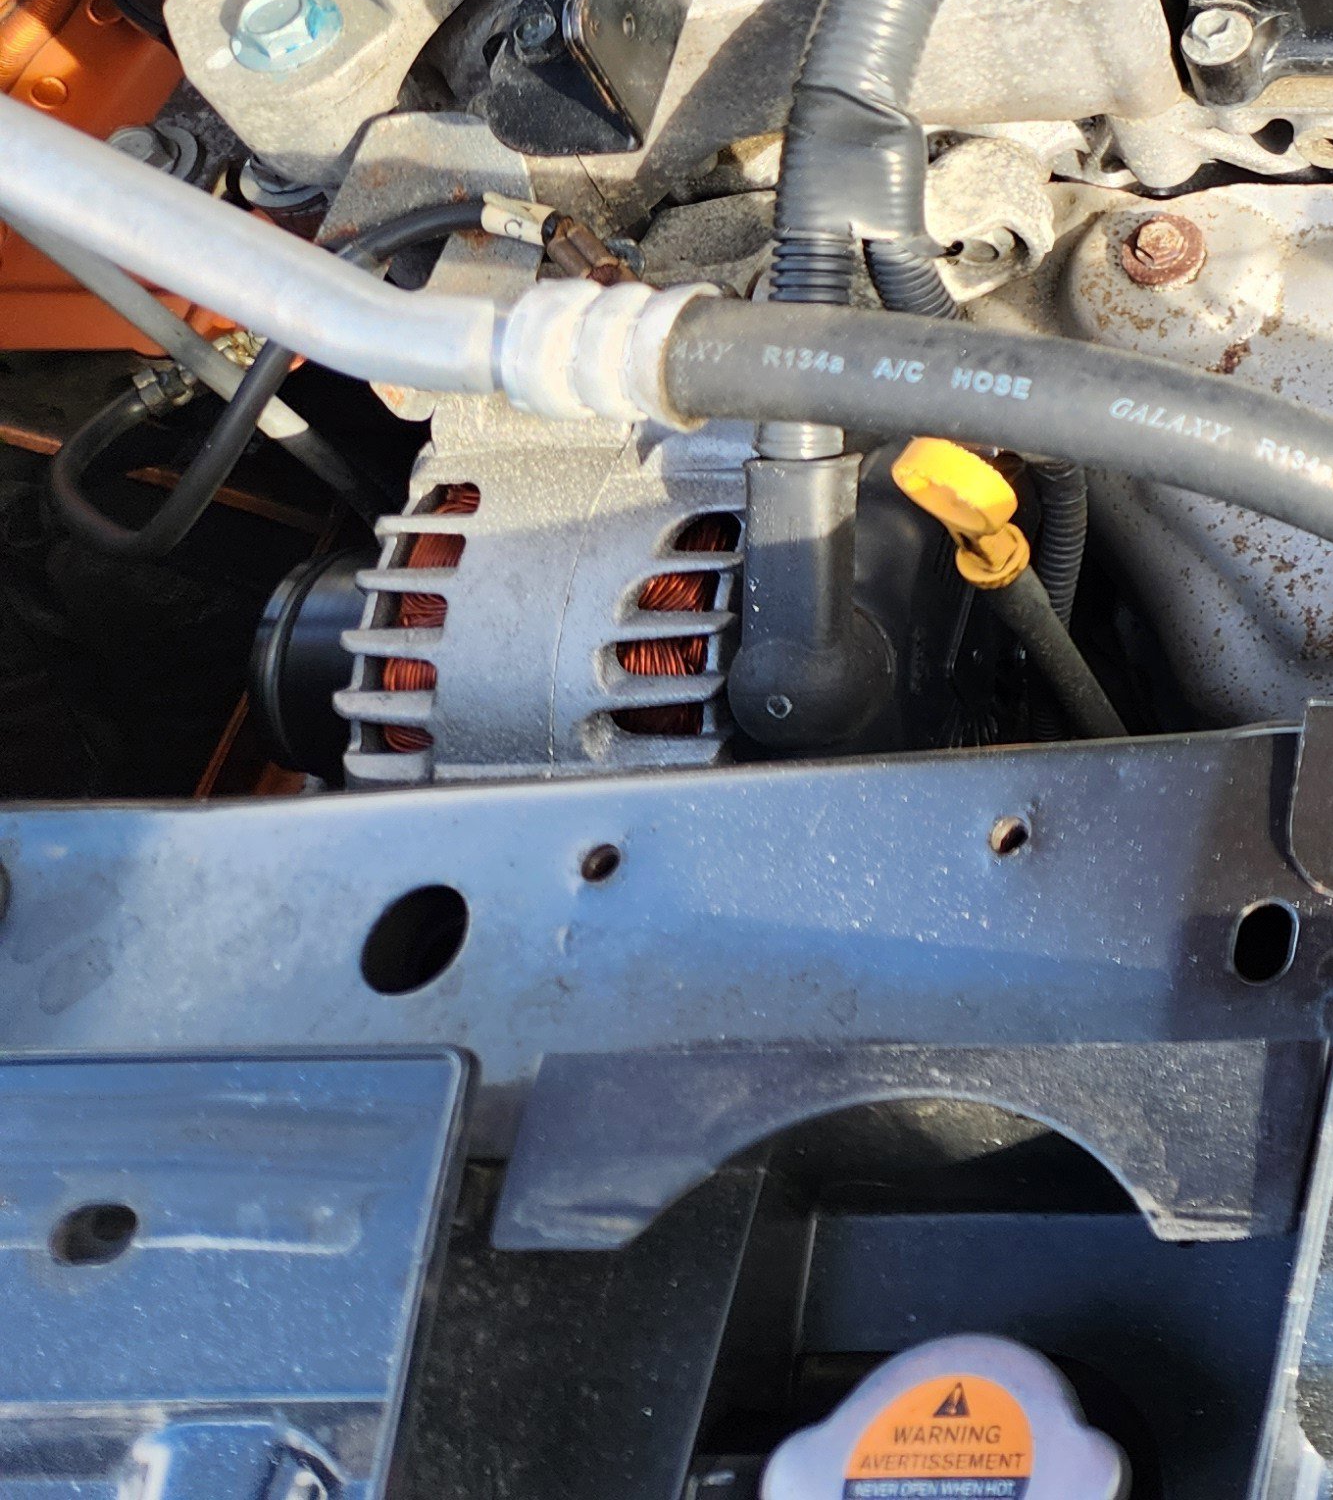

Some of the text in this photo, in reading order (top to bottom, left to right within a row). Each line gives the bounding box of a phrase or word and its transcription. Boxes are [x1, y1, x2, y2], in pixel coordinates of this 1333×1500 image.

[761, 344, 846, 375] R134a
[872, 356, 925, 383] A/C
[951, 366, 1033, 400] HOSE
[1109, 396, 1232, 443] GALAXY
[893, 1425, 1003, 1445] WARNING
[860, 1453, 1026, 1471] AVERTISSEMENT
[854, 1481, 899, 1497] NEVER
[901, 1480, 937, 1497] OPEN
[941, 1480, 984, 1497] WHEN
